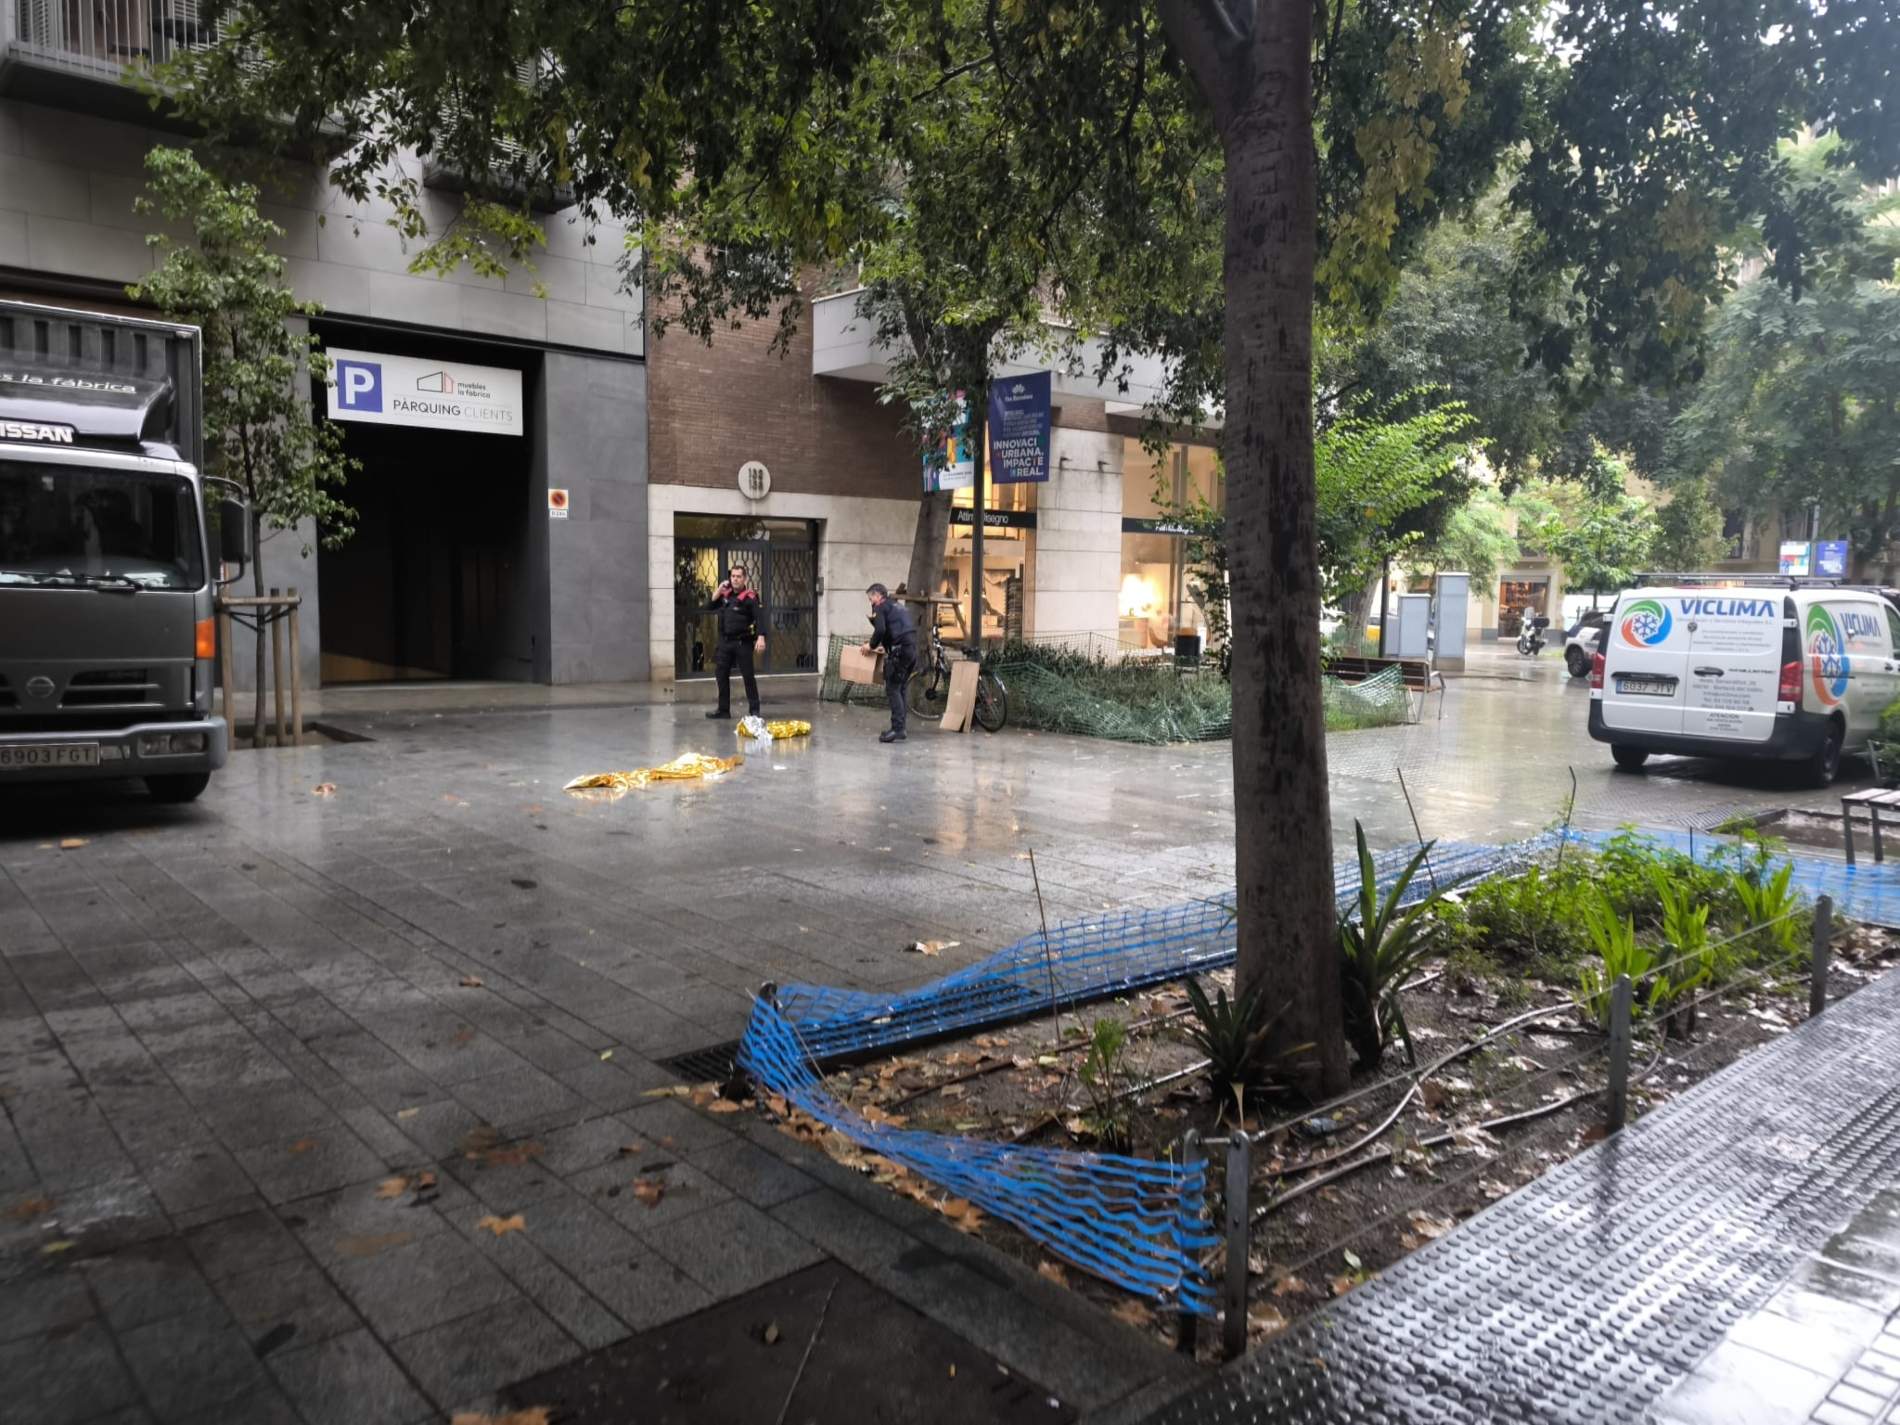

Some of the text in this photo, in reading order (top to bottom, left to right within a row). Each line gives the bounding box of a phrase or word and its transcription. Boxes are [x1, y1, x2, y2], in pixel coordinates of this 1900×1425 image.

[22, 373, 44, 384] la
[345, 366, 375, 405] P
[458, 382, 486, 391] muebles
[393, 397, 513, 423] PÀRQUING CLIENTS
[0, 422, 74, 444] ISSAN
[1004, 456, 1044, 470] IMPACTE
[1680, 599, 1775, 618] VICLIMA
[1840, 612, 1882, 638] VICLIMA
[0, 747, 92, 765] 6903 FGT
